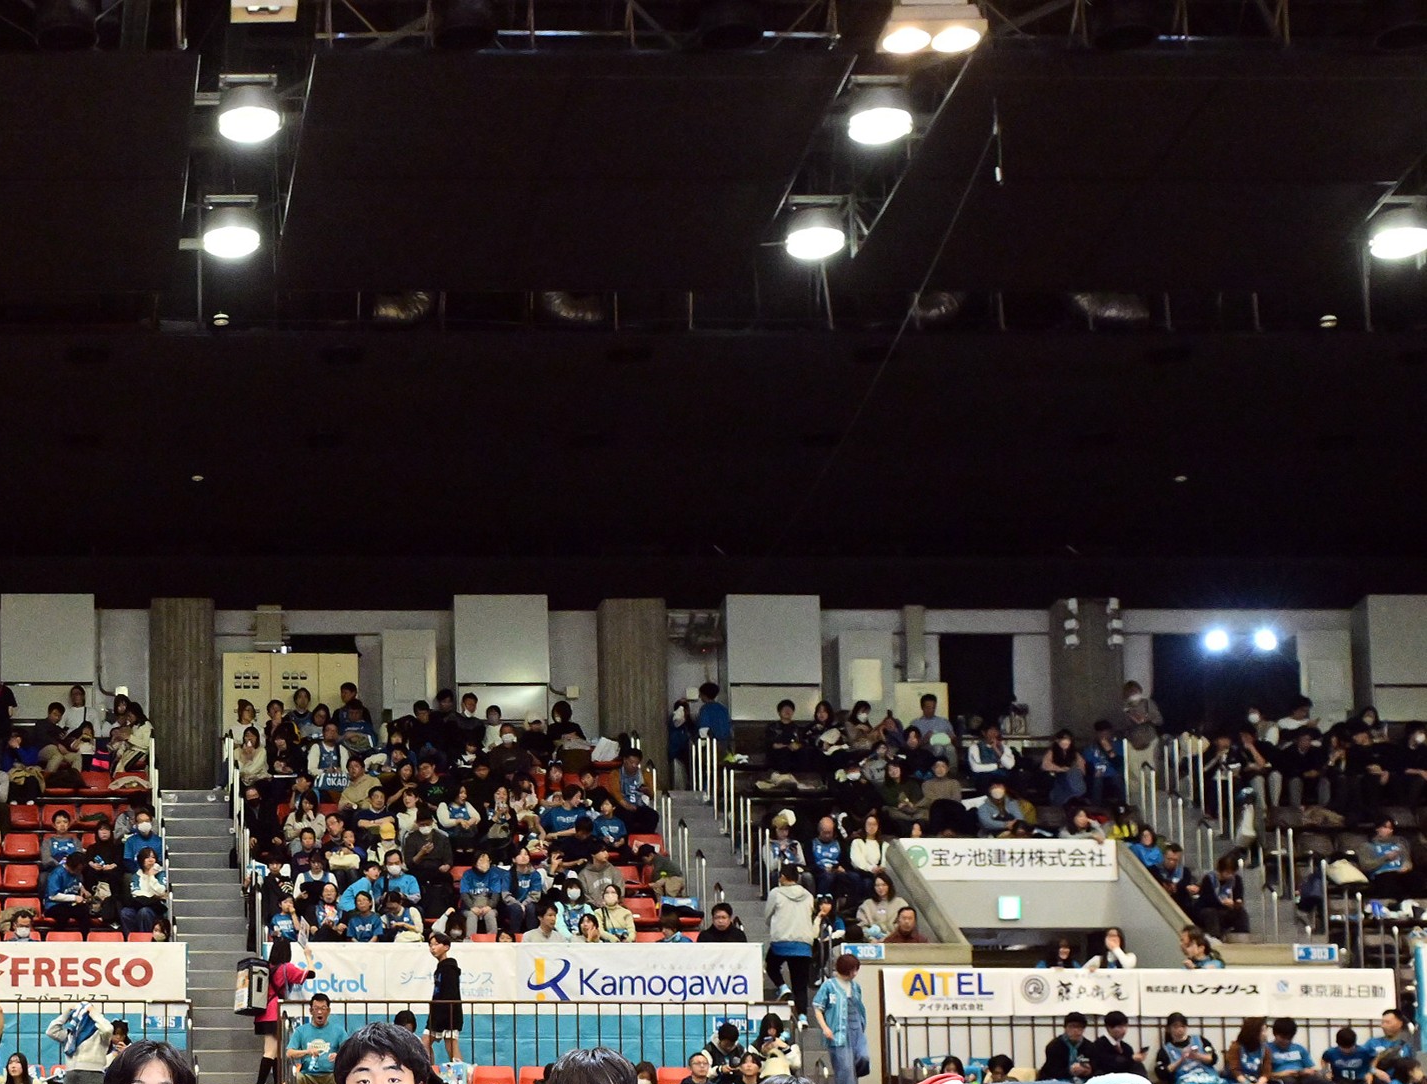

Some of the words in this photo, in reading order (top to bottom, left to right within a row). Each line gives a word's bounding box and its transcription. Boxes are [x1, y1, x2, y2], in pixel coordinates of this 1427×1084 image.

[10, 957, 154, 988] FRESCO
[578, 967, 749, 1003] Kamogawa
[907, 972, 995, 997] AITEL
[1299, 983, 1386, 999] 東京海上日動
